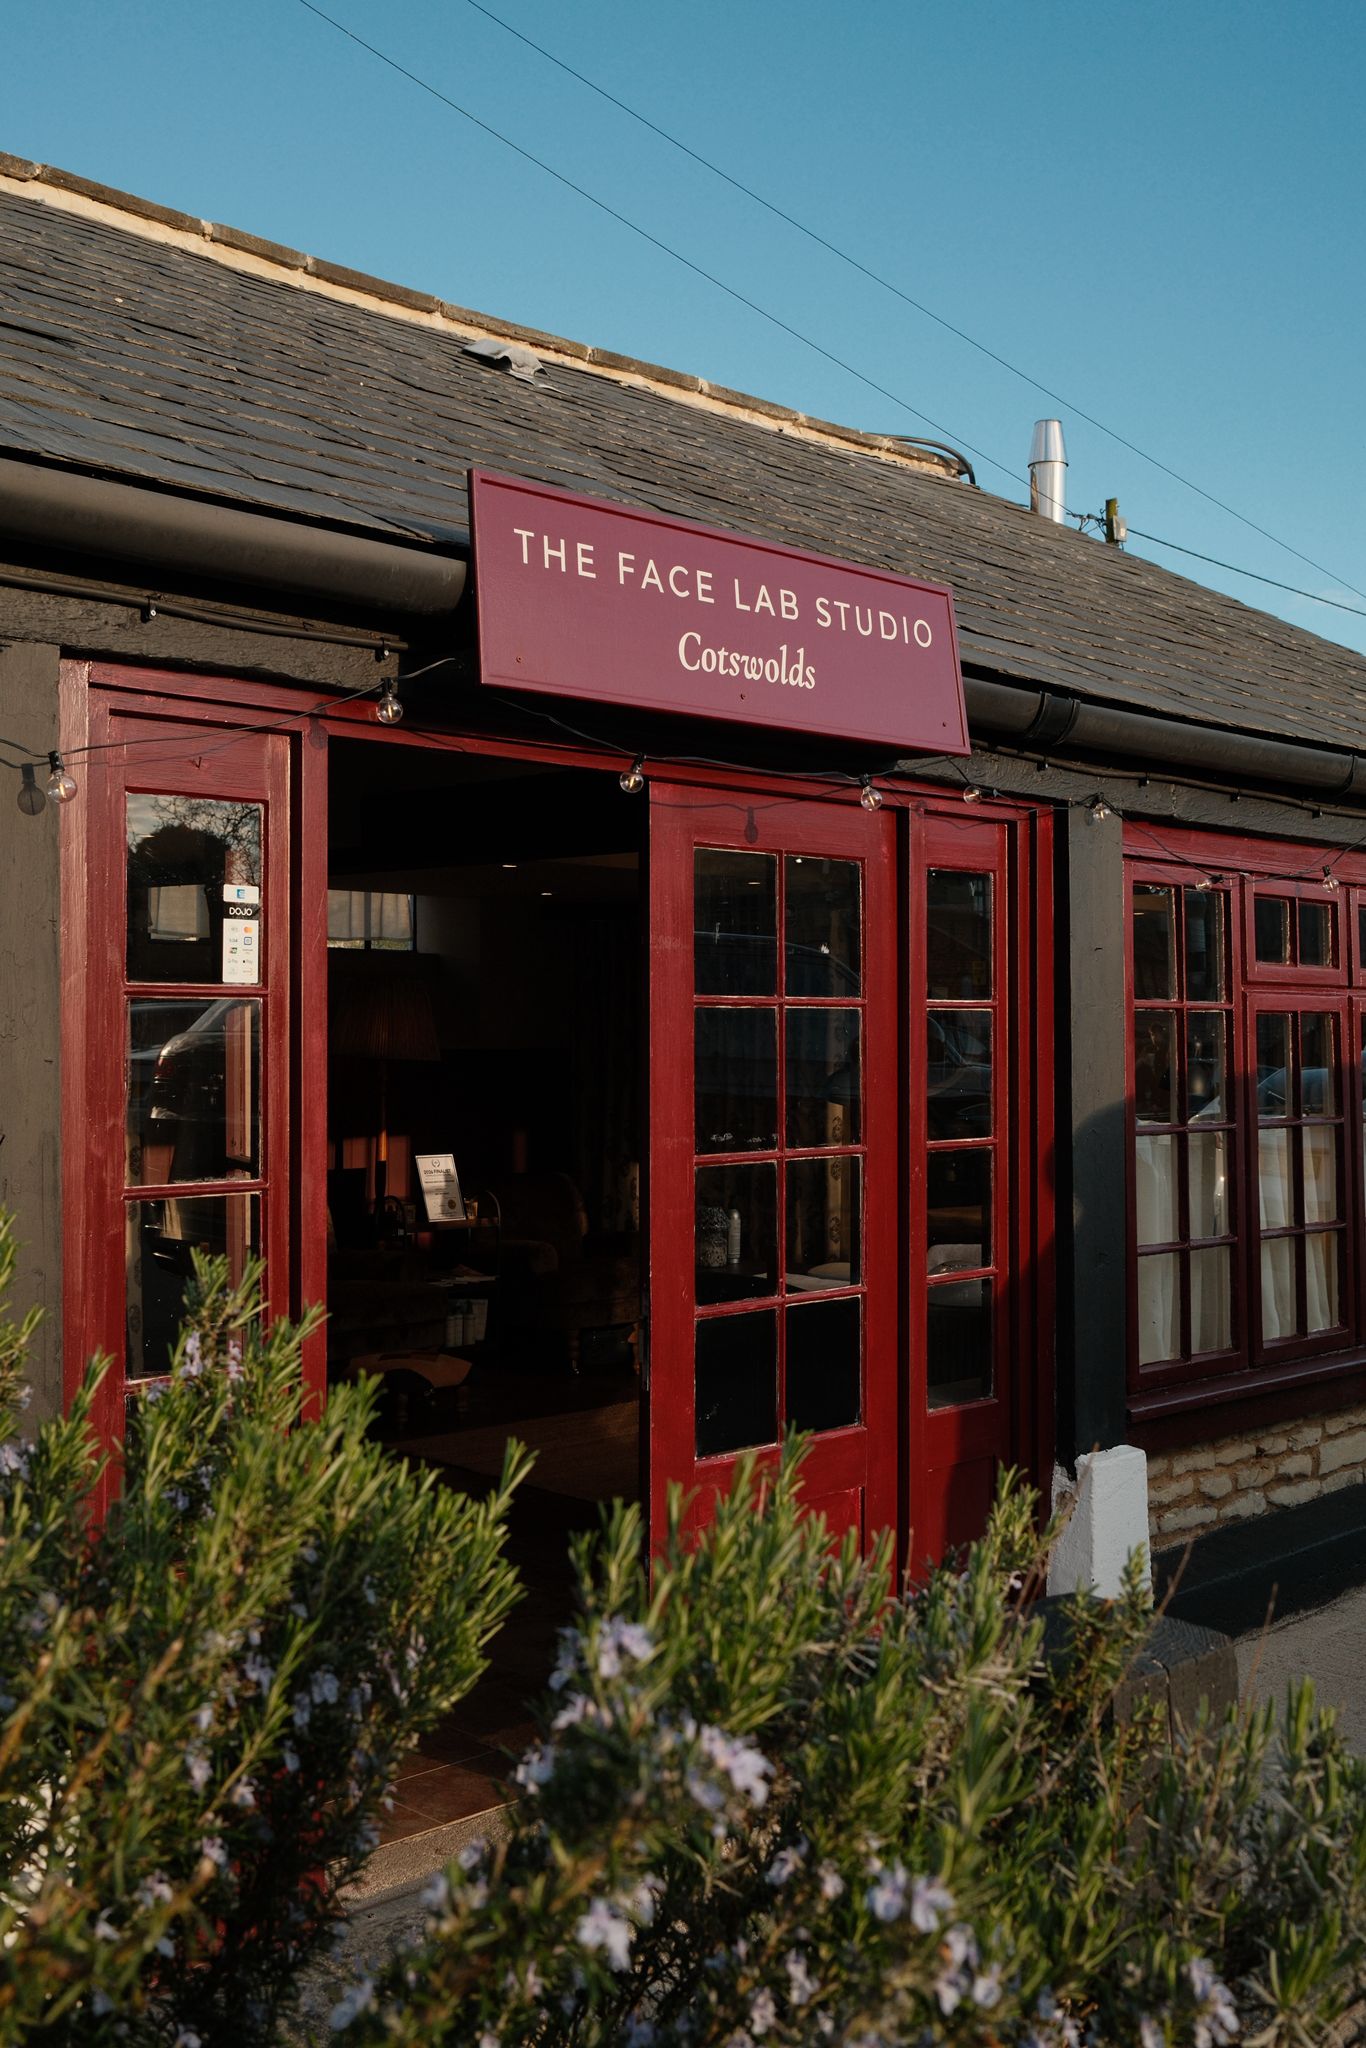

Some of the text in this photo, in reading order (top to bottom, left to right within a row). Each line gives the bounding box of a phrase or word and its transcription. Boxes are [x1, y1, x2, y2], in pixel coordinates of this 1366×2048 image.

[514, 528, 932, 648] THE FACE LAB STUDIO
[678, 632, 815, 689] Cotswolds
[229, 907, 252, 916] DOJO
